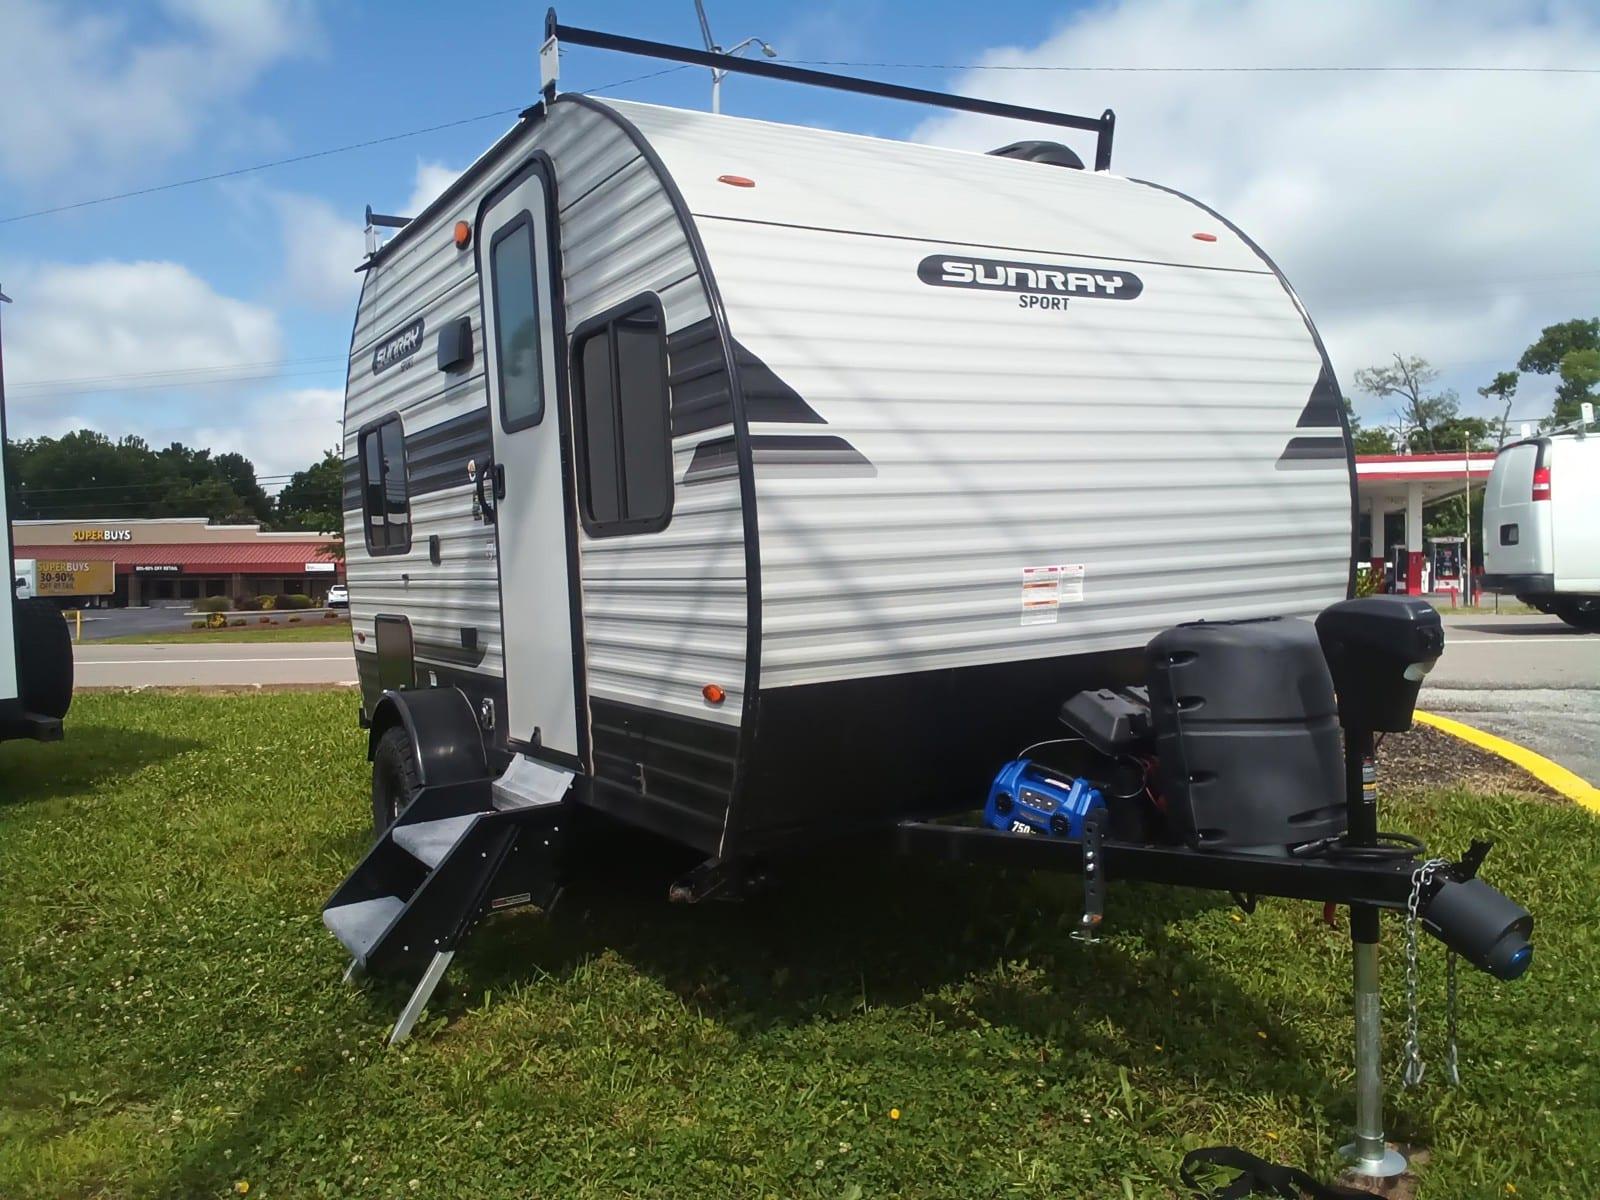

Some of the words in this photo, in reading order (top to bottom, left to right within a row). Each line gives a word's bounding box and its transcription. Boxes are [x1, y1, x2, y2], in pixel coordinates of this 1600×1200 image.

[941, 261, 1124, 294] SUNRAY
[1018, 294, 1070, 311] SPORT
[377, 326, 420, 366] SUNRAY
[72, 529, 131, 541] SUPERBUYS
[38, 562, 90, 572] SUPERBUYS
[40, 572, 75, 582] 30-90%
[1011, 820, 1031, 833] 750
